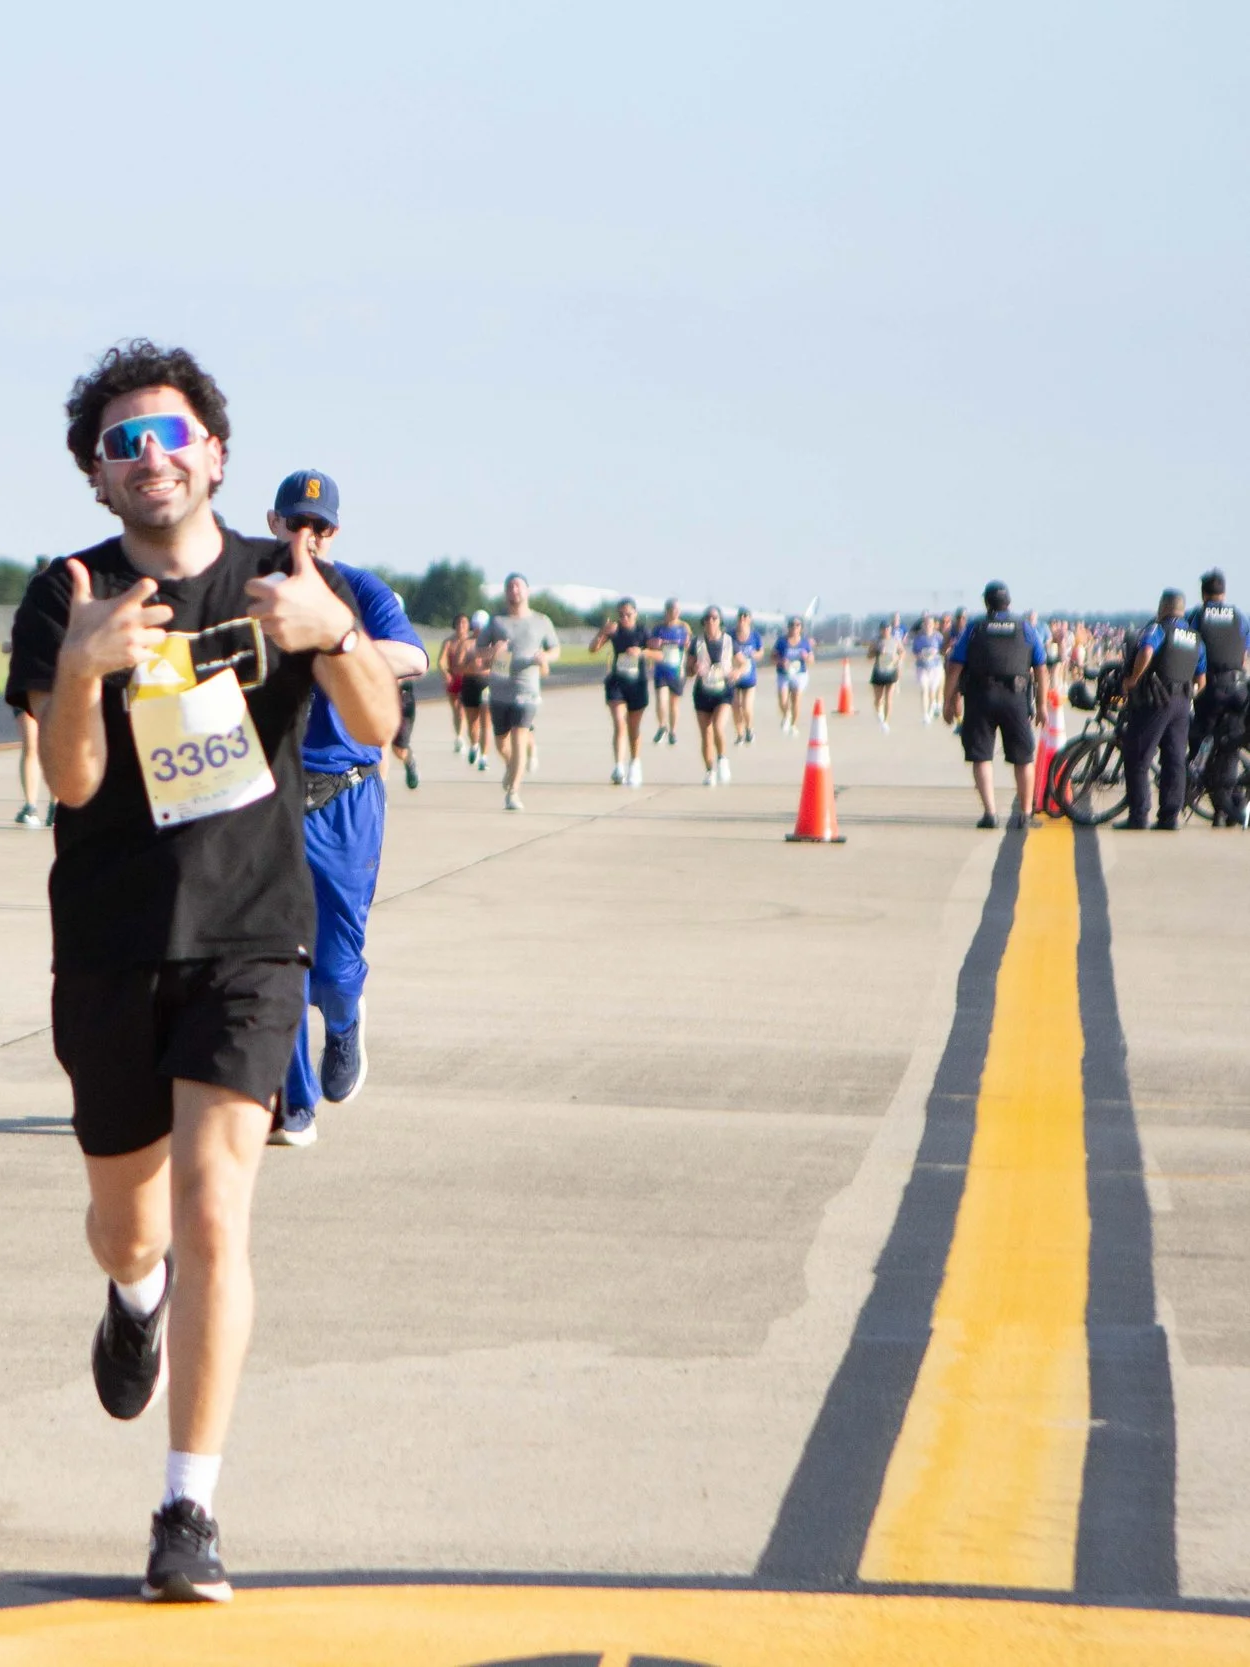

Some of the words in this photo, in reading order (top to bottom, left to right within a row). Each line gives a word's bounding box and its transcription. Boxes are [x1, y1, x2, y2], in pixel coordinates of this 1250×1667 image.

[1205, 607, 1234, 618] POLICE
[1174, 628, 1197, 643] POLICE
[151, 725, 249, 782] 3363
